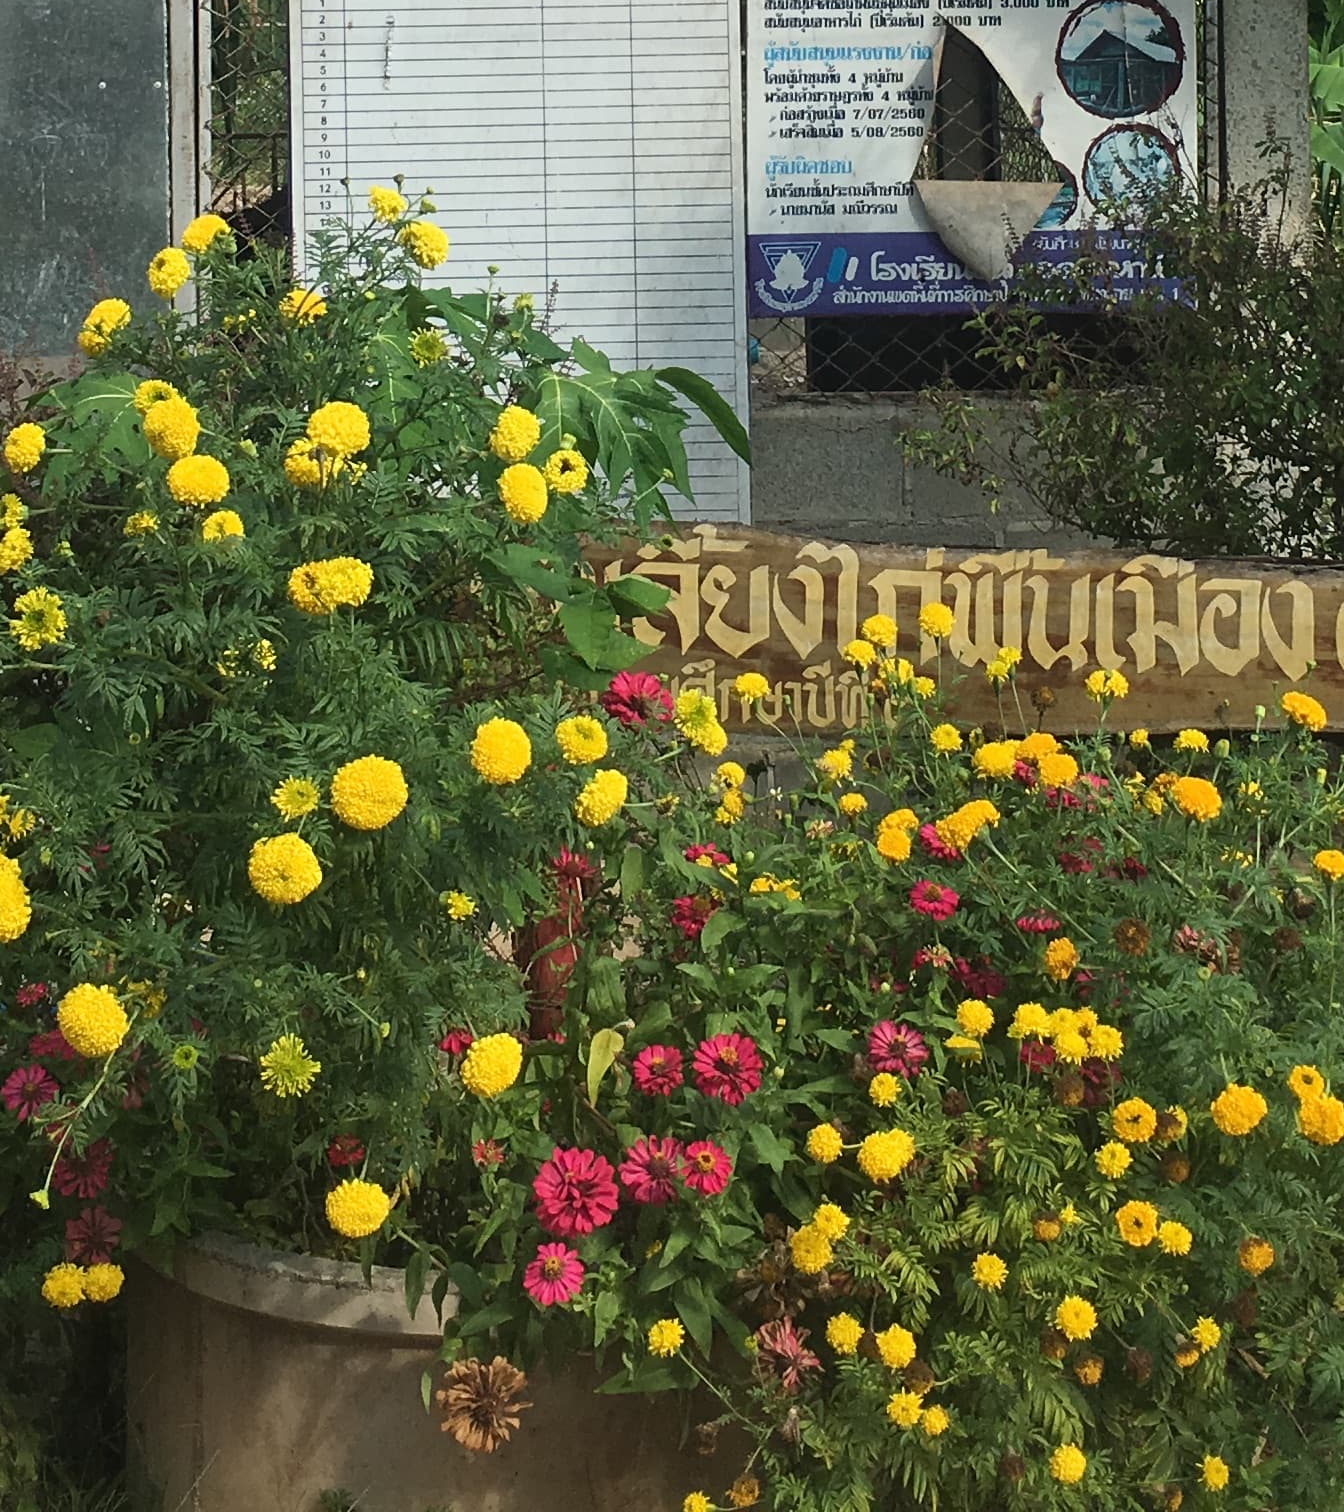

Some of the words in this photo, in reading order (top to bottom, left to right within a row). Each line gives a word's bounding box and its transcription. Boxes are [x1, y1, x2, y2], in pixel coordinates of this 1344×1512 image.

[320, 0, 324, 7] 1
[320, 15, 325, 24] 2
[978, 15, 1001, 26] บาท
[320, 32, 325, 41] 3
[320, 49, 326, 58] 4
[320, 65, 326, 75] 5
[848, 73, 856, 83] 4
[320, 83, 326, 92] 6
[881, 90, 889, 101] 4
[321, 99, 327, 109] 7
[853, 107, 925, 120] 7/07/2560
[321, 116, 327, 125] 8
[851, 125, 924, 138] 5/08/2560
[321, 133, 327, 142] 9
[318, 150, 330, 159] 10
[320, 168, 331, 177] 11
[765, 155, 852, 181] ผู้รับผิดชอบ
[320, 184, 331, 193] 12
[320, 201, 331, 210] 13
